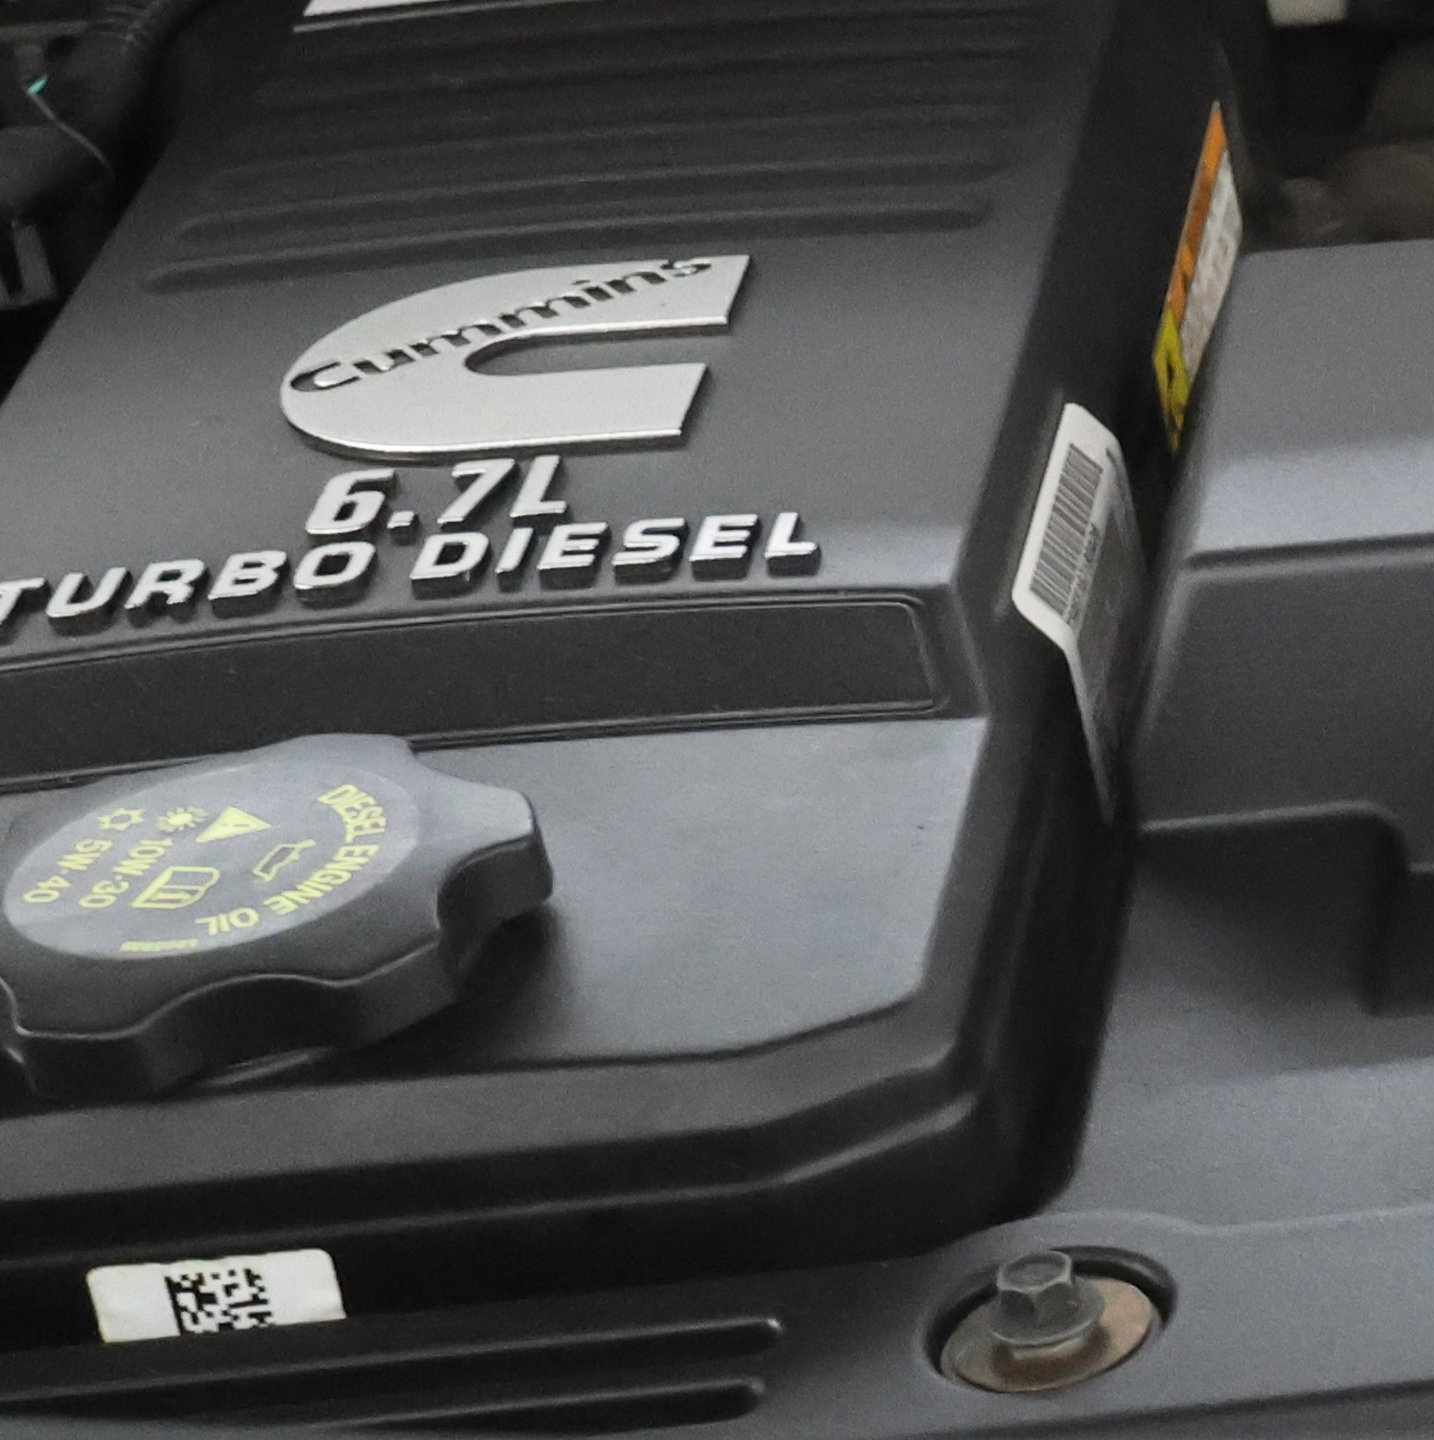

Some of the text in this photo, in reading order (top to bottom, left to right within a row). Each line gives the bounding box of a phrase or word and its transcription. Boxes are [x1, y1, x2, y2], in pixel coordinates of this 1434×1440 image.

[290, 258, 712, 392] Cummins
[305, 455, 568, 535] 6.7L
[0, 511, 818, 626] TURBO DIESEL
[195, 783, 390, 936] DIESEL ENGINE OIL
